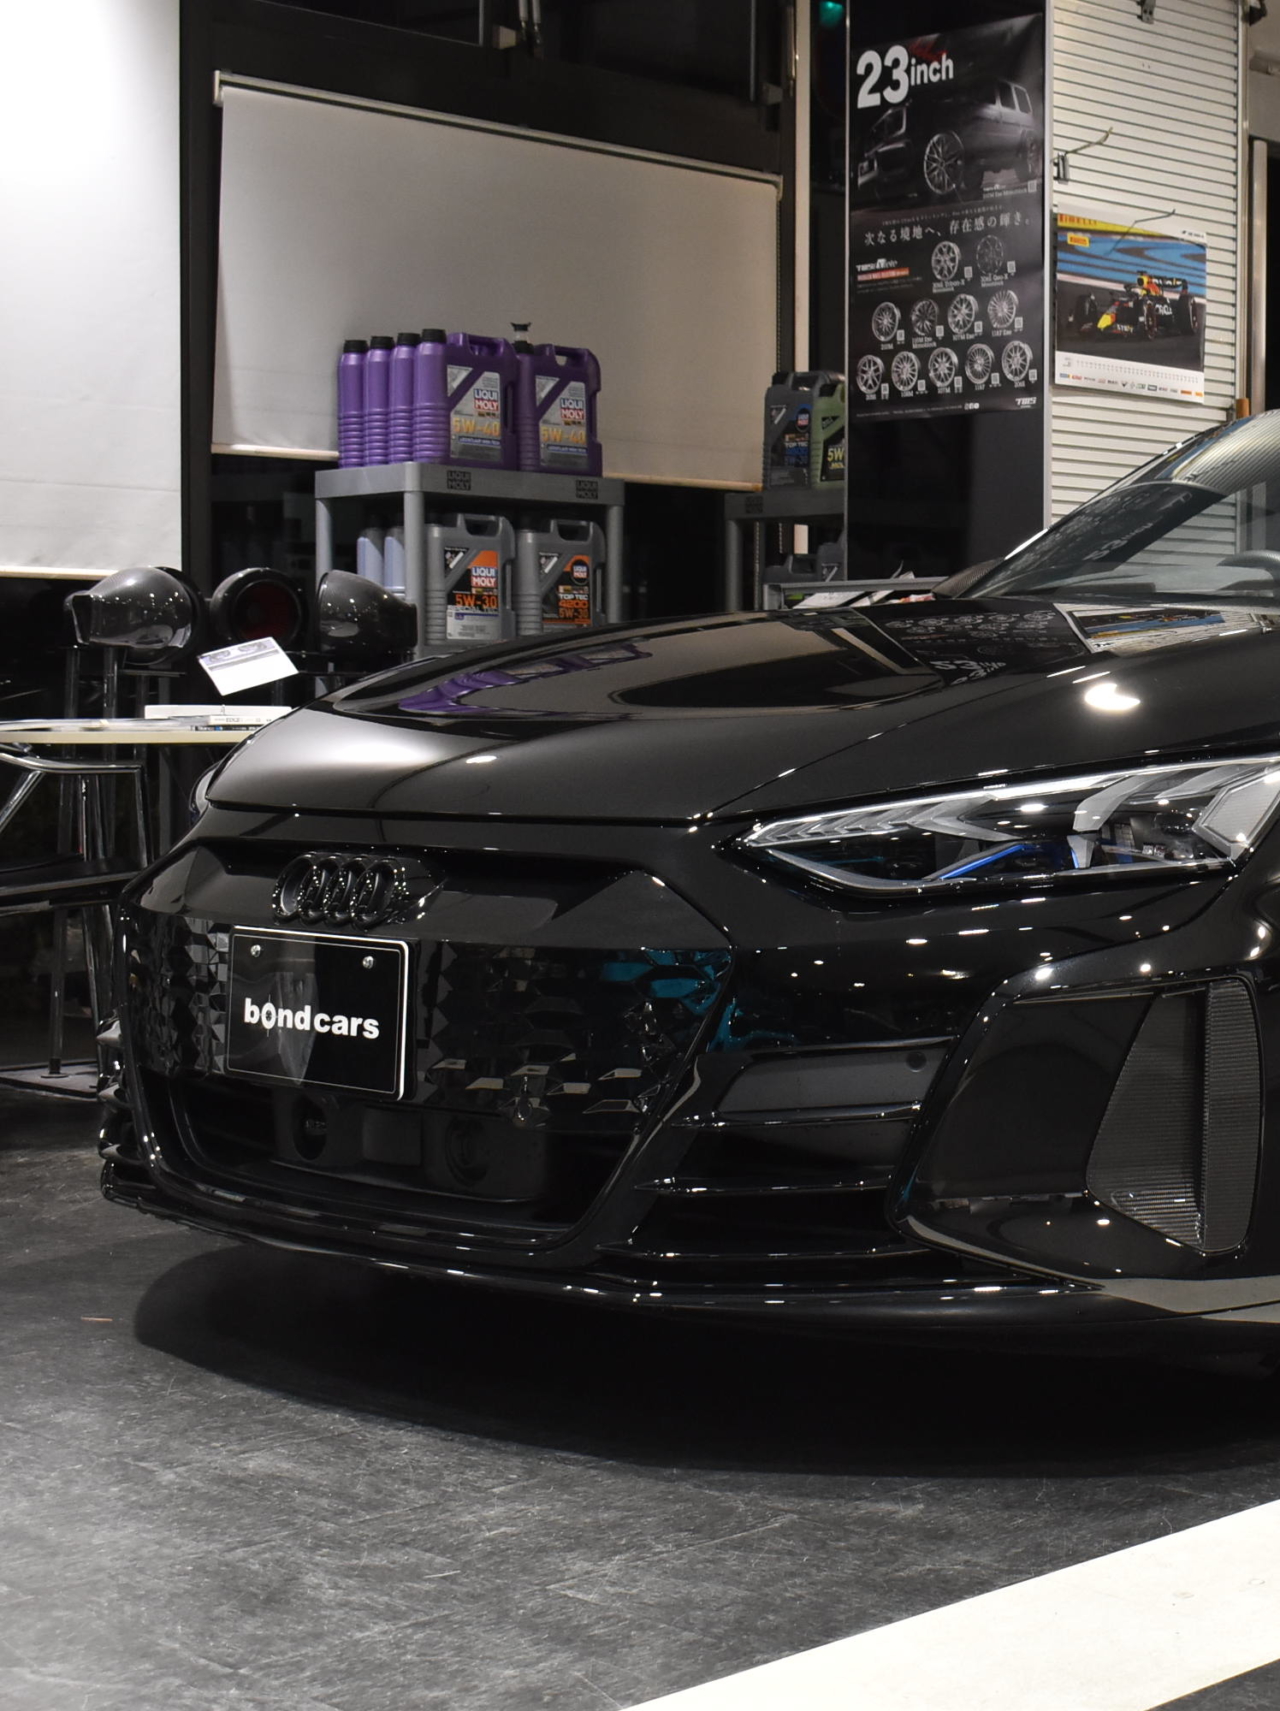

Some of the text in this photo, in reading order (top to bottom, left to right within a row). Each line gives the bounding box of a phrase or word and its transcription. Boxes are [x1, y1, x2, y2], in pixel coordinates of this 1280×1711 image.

[474, 389, 498, 400] LIQUI
[475, 400, 499, 411] MOLY
[561, 399, 583, 409] LIQUI
[561, 409, 584, 420] MOLY
[452, 417, 500, 437] 5W-40
[541, 426, 587, 445] 5W-40
[472, 567, 496, 577] LIQUI
[472, 576, 497, 587] MOLY
[455, 594, 498, 609] 5W-30
